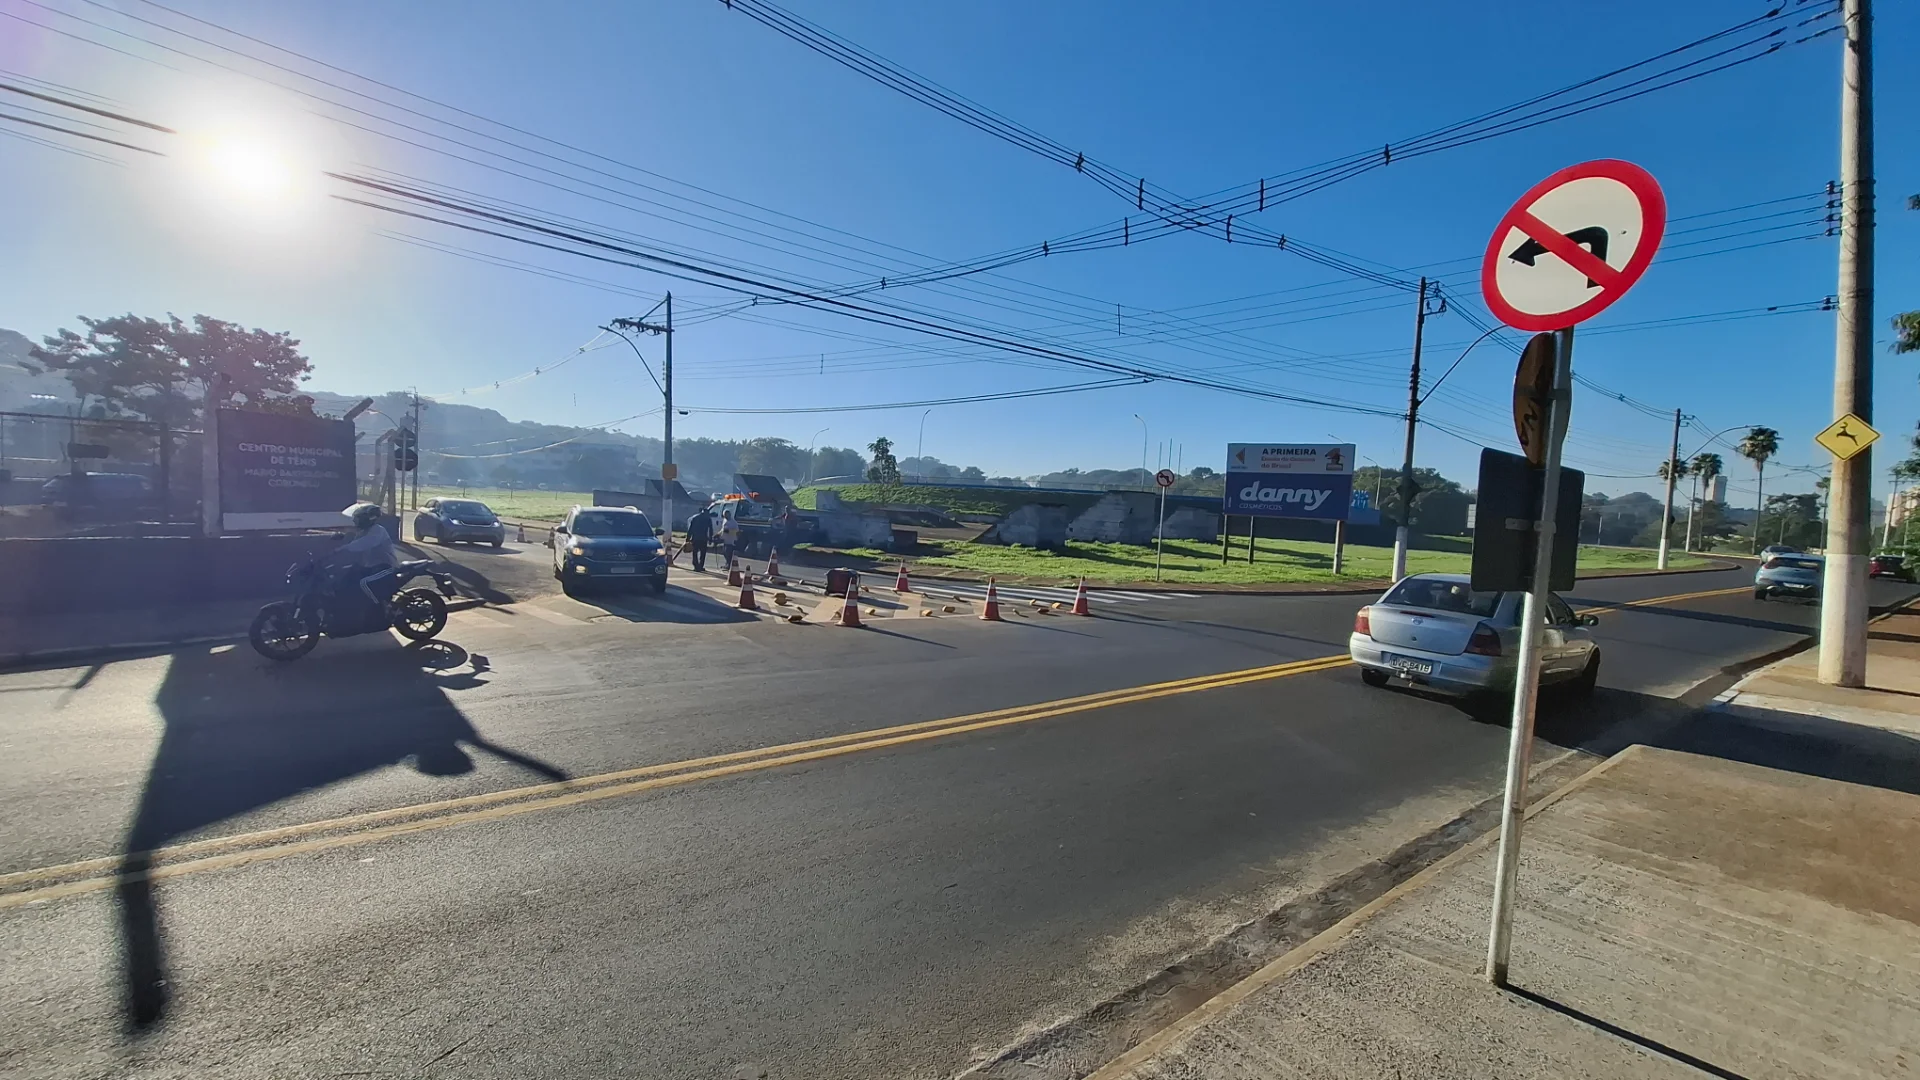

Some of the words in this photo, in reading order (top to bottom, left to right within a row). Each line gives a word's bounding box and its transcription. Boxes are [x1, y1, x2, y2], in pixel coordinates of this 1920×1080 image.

[238, 442, 287, 454] CENTRO
[289, 446, 344, 458] MUNICIPAL
[1262, 448, 1269, 456] A
[1270, 448, 1317, 456] PRIMEIRA
[270, 455, 285, 465] DE
[1239, 480, 1333, 511] danny
